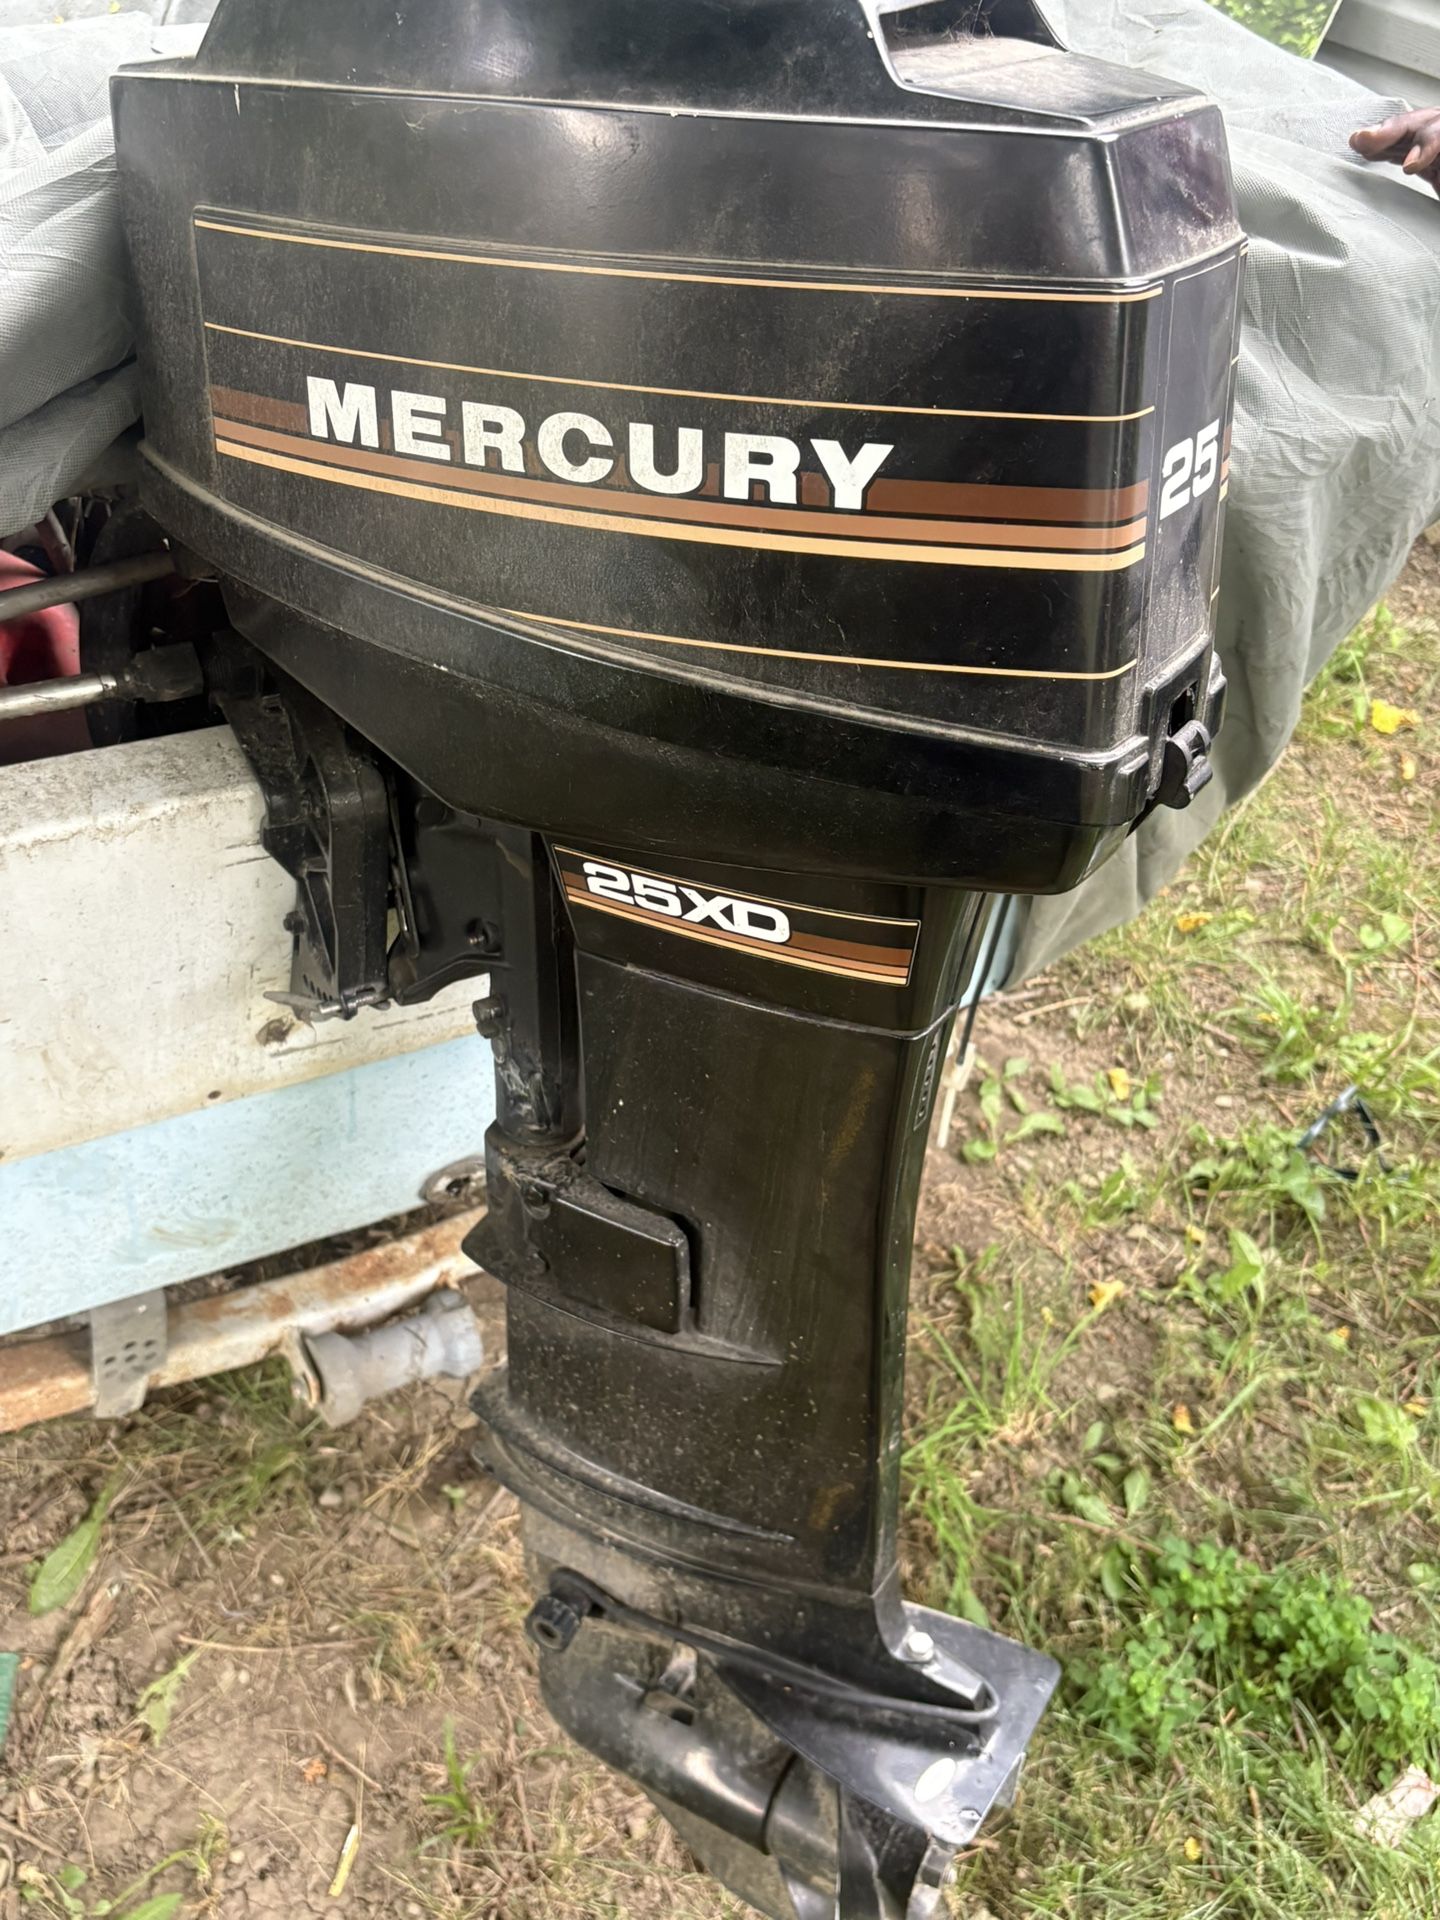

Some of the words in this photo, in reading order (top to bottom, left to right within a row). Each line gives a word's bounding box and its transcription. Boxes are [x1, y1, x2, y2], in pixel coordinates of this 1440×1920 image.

[305, 375, 893, 511] MERCURY
[1159, 418, 1220, 520] 25
[582, 861, 791, 944] 25XD
